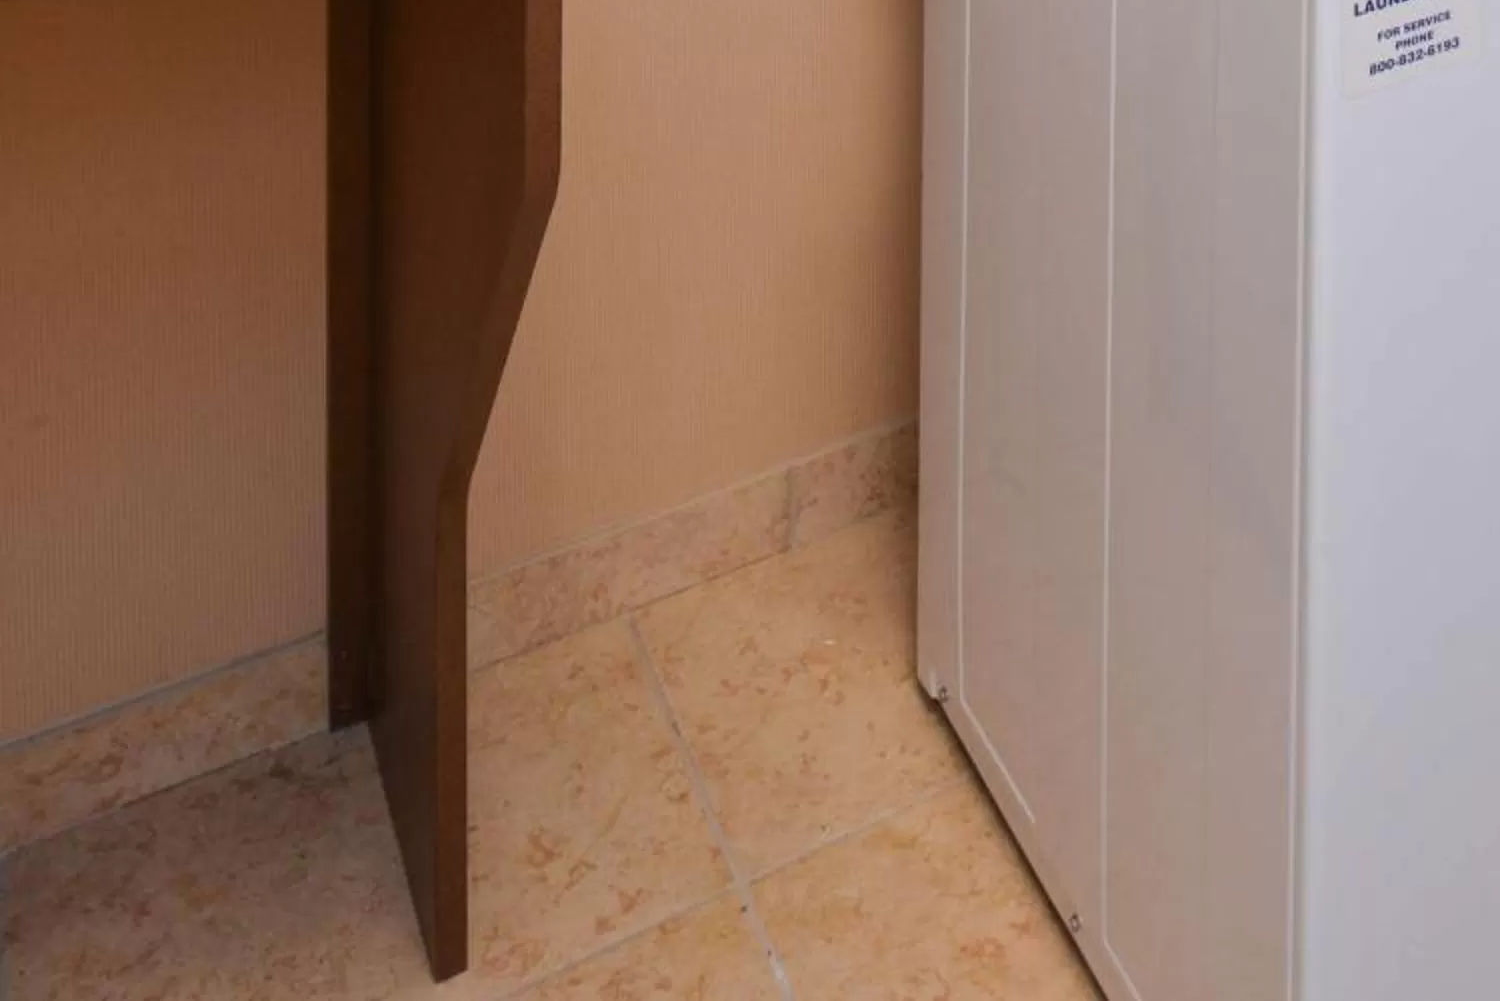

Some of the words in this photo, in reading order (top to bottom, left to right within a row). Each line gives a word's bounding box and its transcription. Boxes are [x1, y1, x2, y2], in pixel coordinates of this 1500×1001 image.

[1377, 26, 1401, 42] FOR
[1403, 9, 1451, 33] SERVICE
[1395, 30, 1435, 51] PHONE
